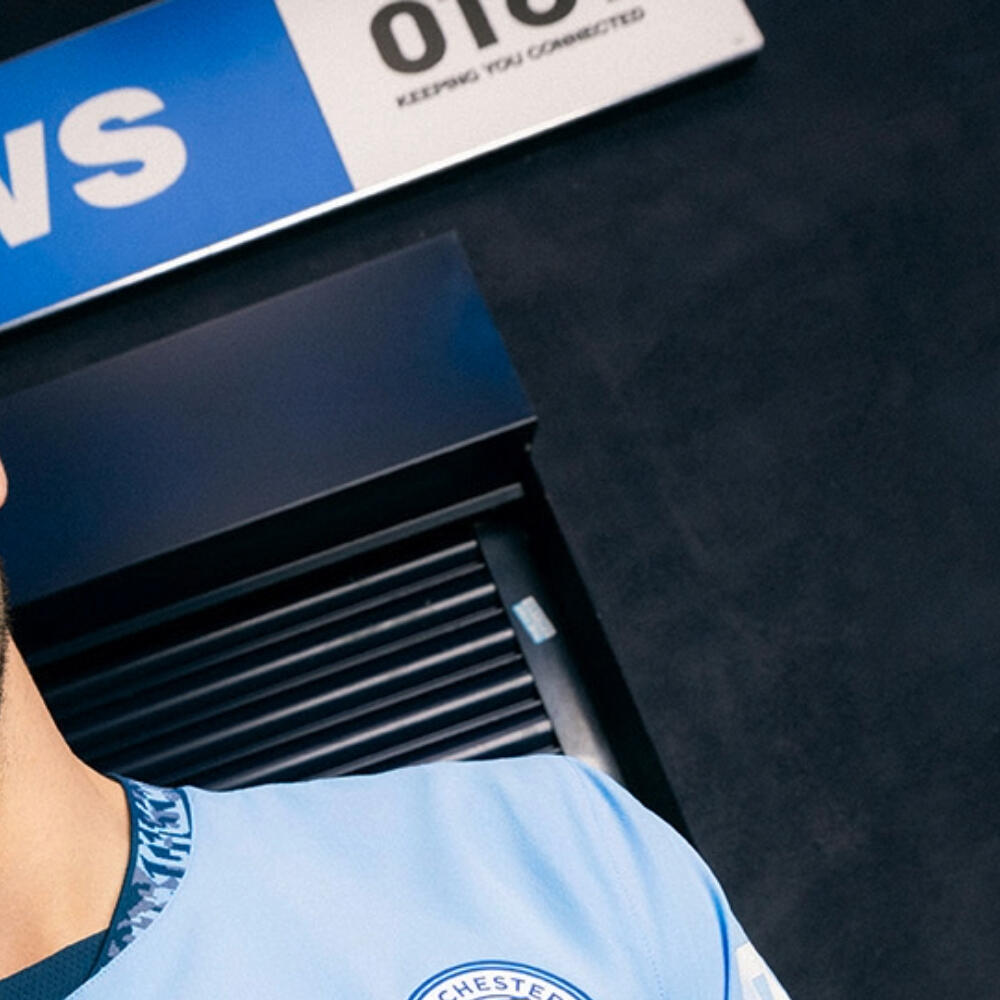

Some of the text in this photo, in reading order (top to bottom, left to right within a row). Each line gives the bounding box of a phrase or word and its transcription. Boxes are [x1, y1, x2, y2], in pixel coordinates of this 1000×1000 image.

[397, 7, 645, 107] KEEPING YOU CONNECTED
